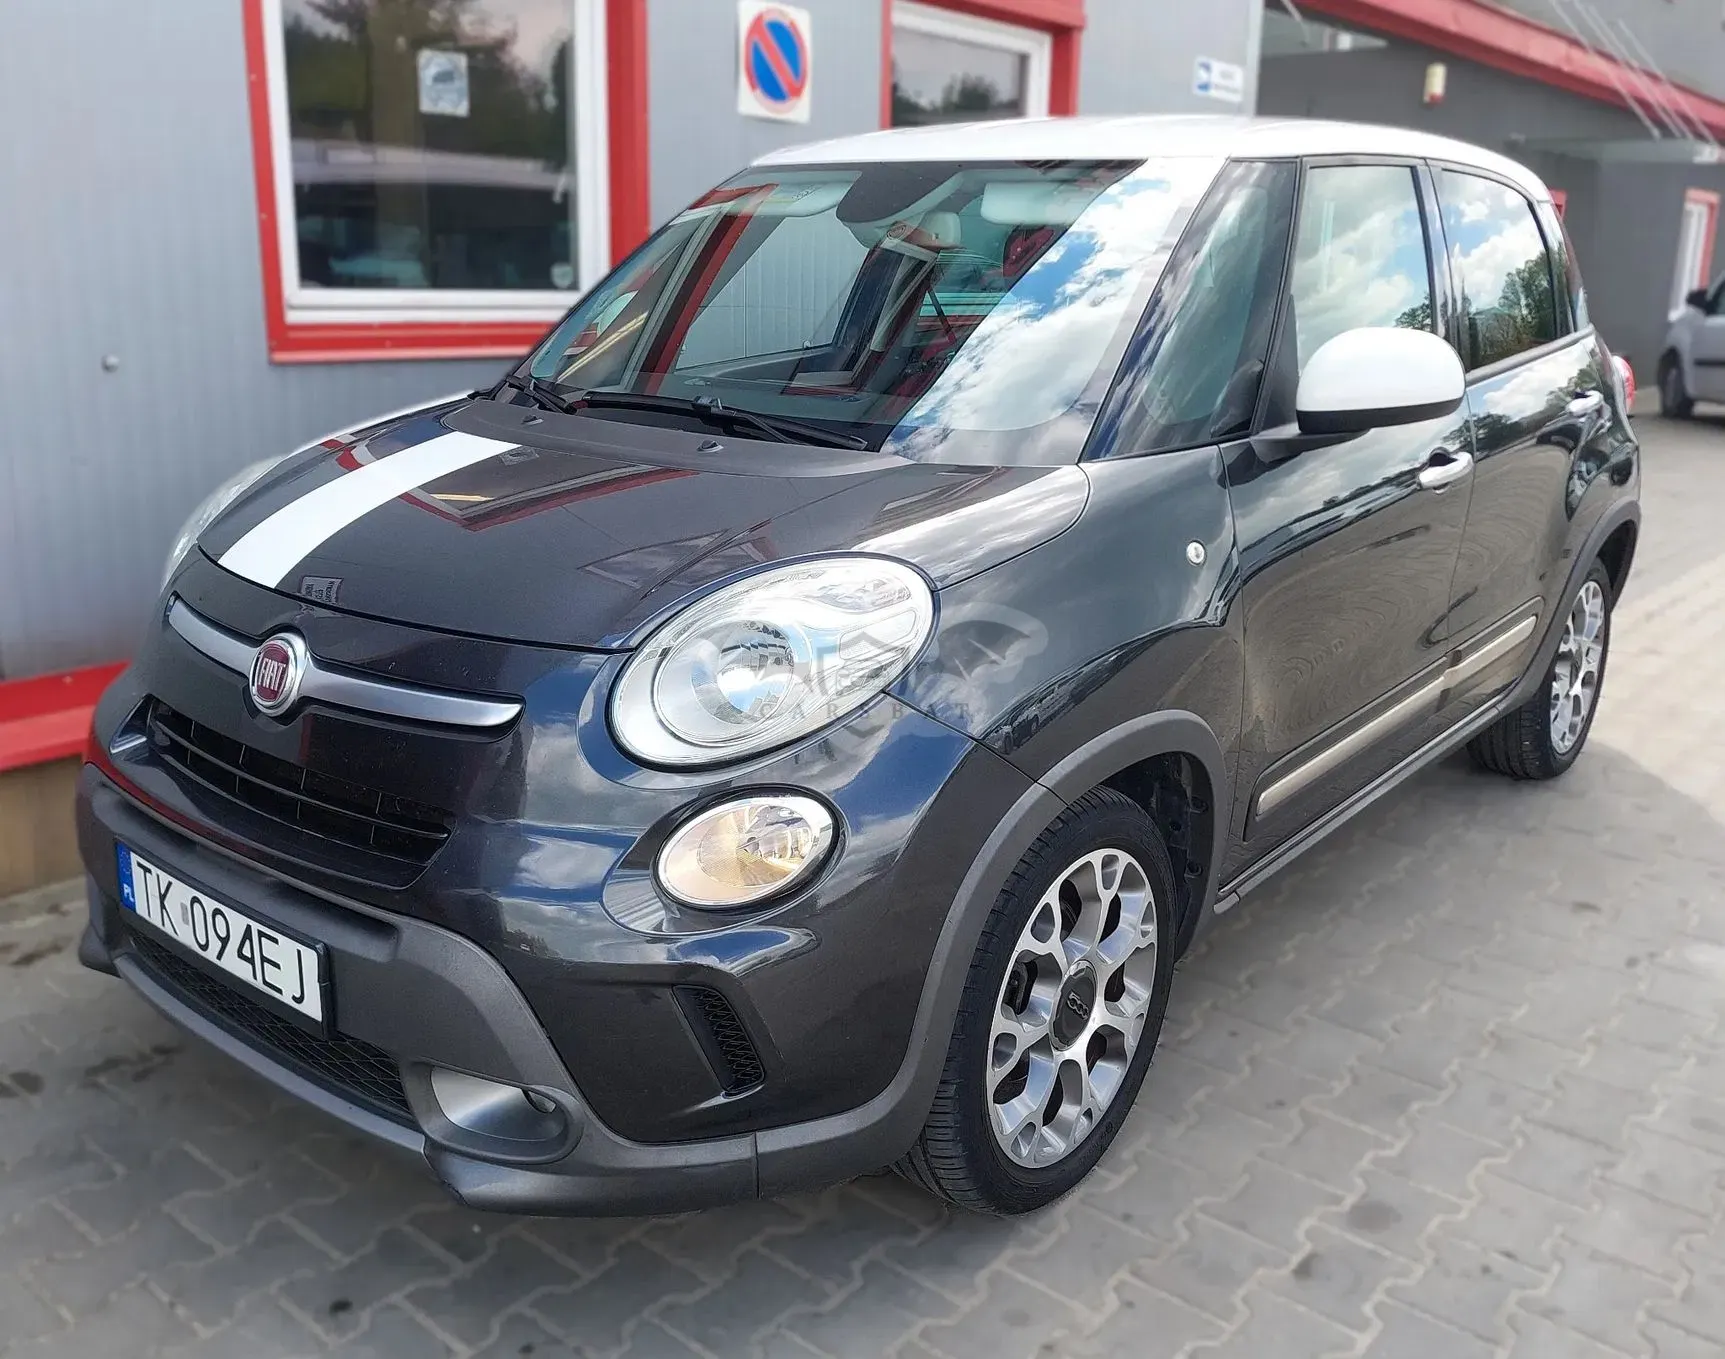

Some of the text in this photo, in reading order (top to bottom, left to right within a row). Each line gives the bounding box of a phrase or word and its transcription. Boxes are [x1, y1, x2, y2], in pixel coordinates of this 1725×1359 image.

[258, 658, 287, 691] FIAT
[123, 883, 135, 902] PL
[136, 861, 305, 1005] TK 094EJ
